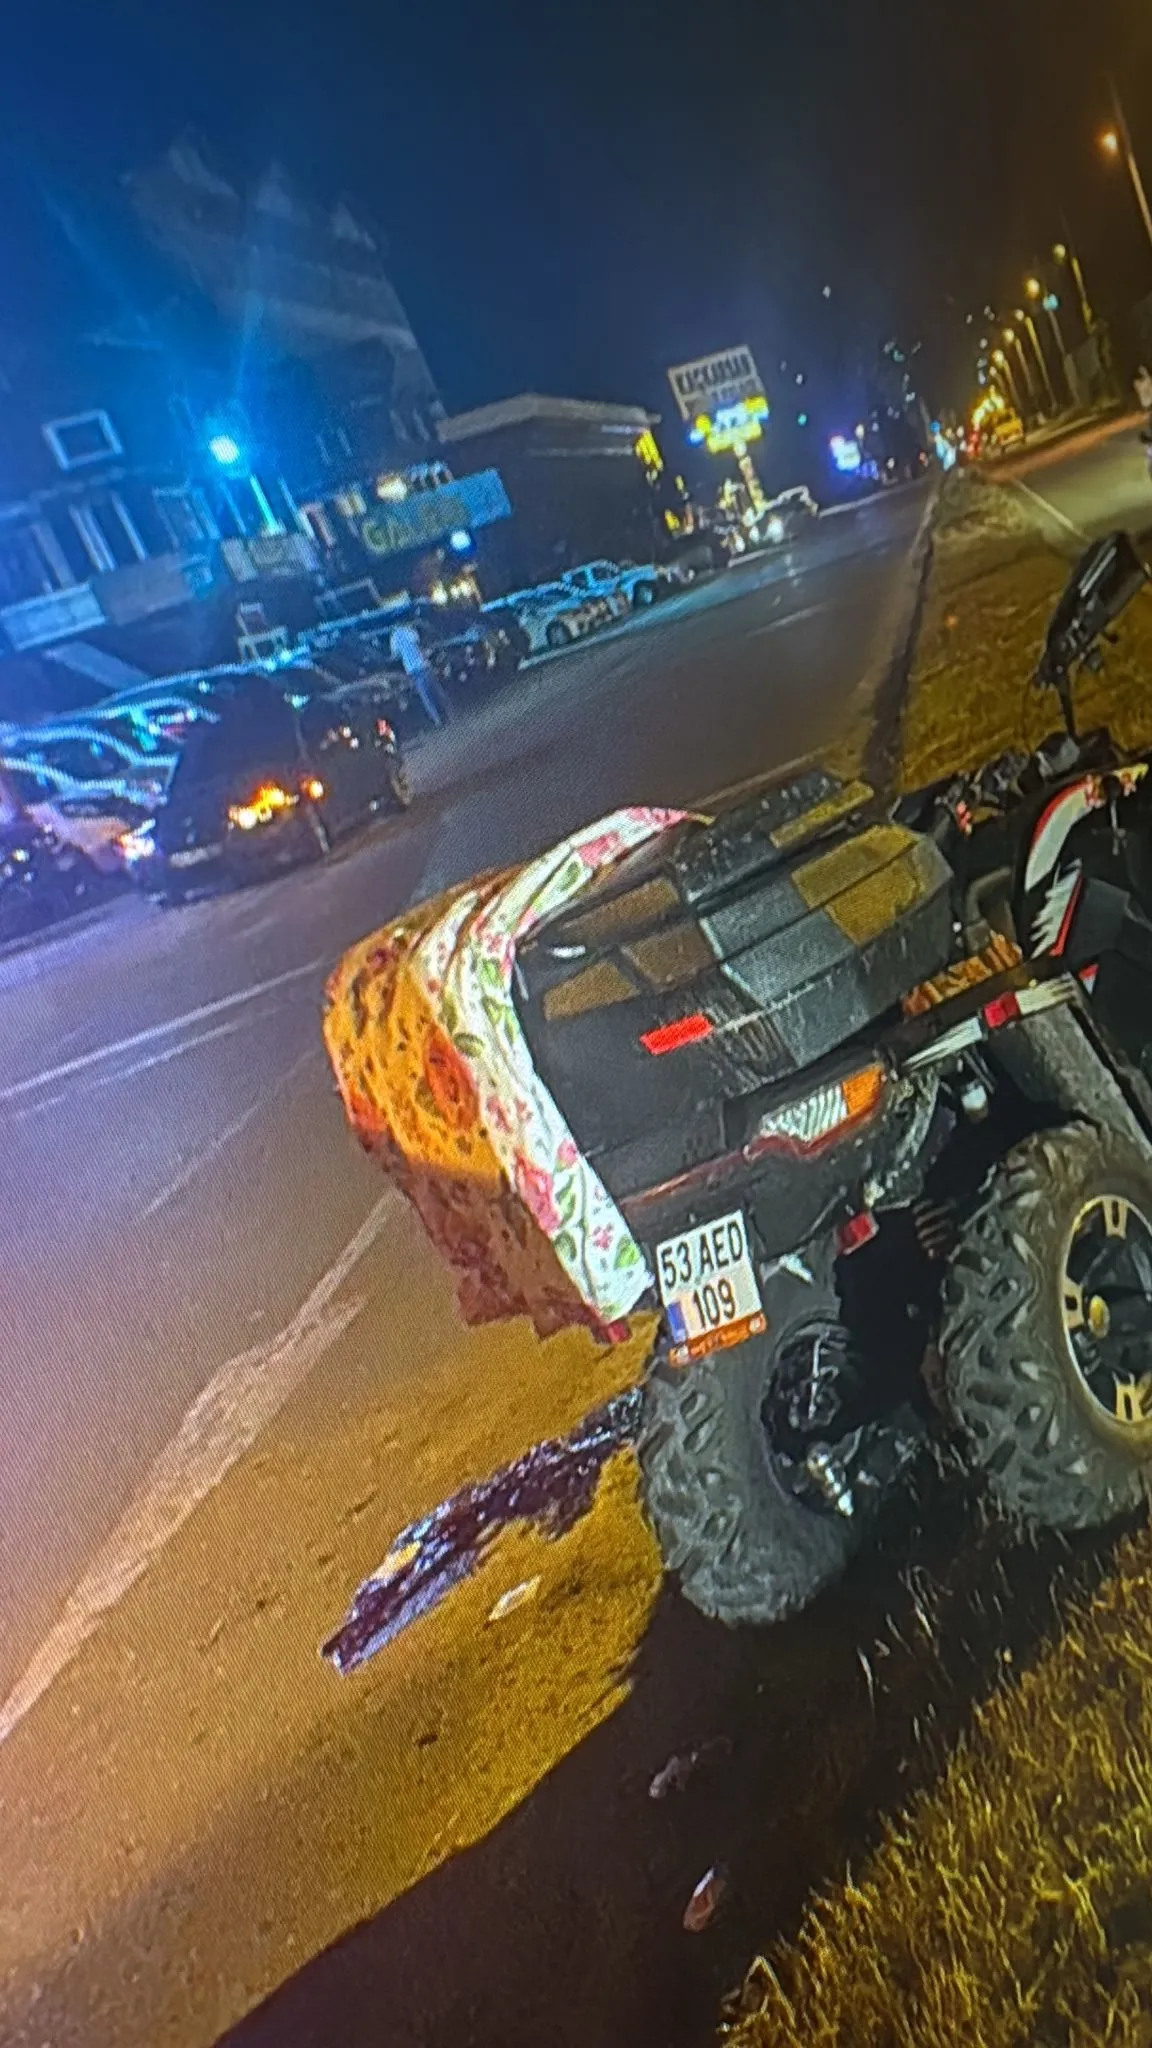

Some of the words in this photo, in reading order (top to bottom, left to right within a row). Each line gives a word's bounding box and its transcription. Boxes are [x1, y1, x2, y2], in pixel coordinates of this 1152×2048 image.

[660, 1241, 692, 1289] 53
[699, 1220, 743, 1274] AED
[692, 1277, 736, 1329] 109
